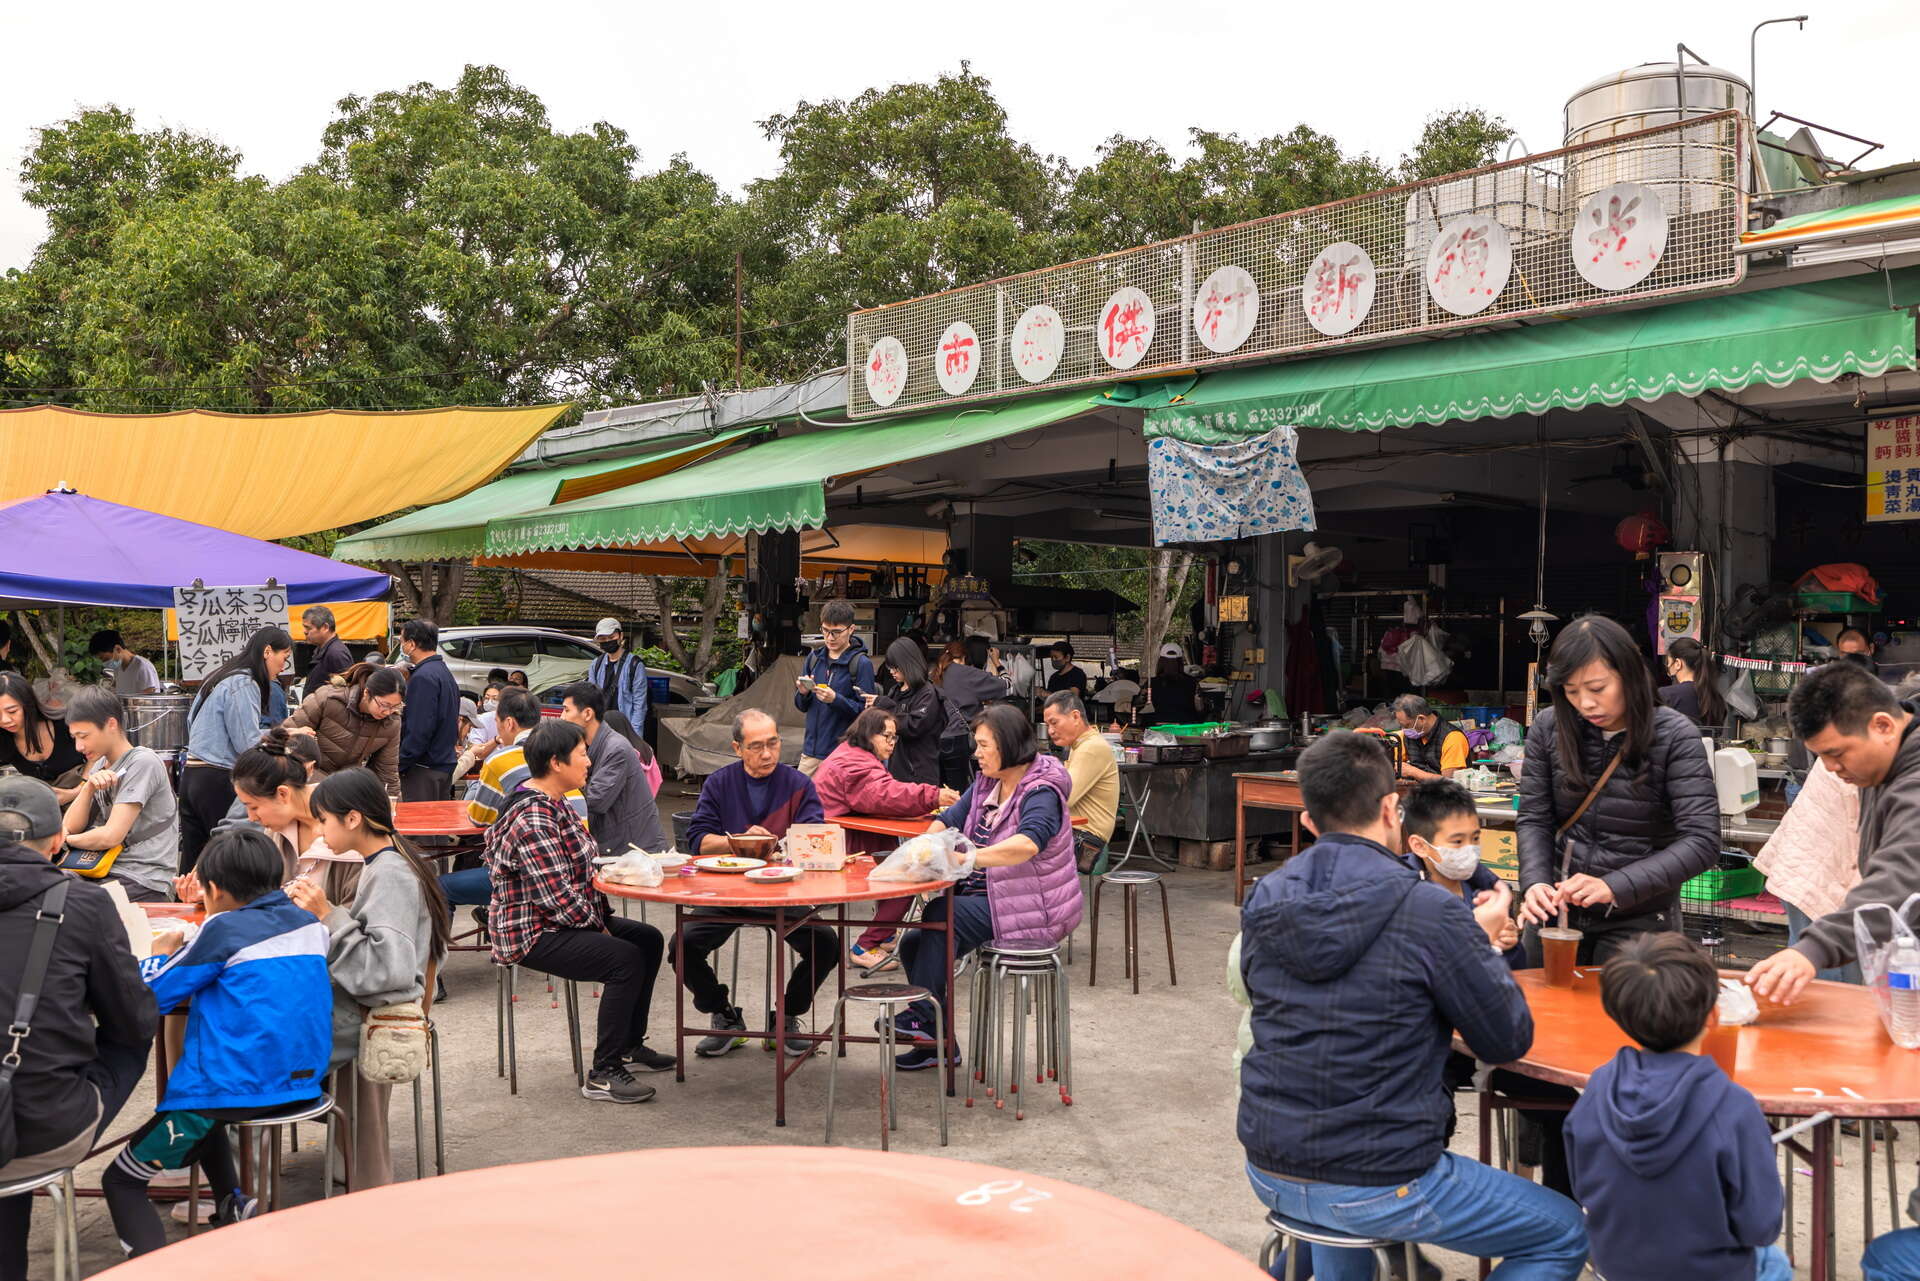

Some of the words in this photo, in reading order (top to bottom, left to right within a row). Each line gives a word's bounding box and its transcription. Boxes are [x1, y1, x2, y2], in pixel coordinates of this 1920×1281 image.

[180, 588, 248, 616] 冬瓜茶
[253, 593, 285, 613] 30
